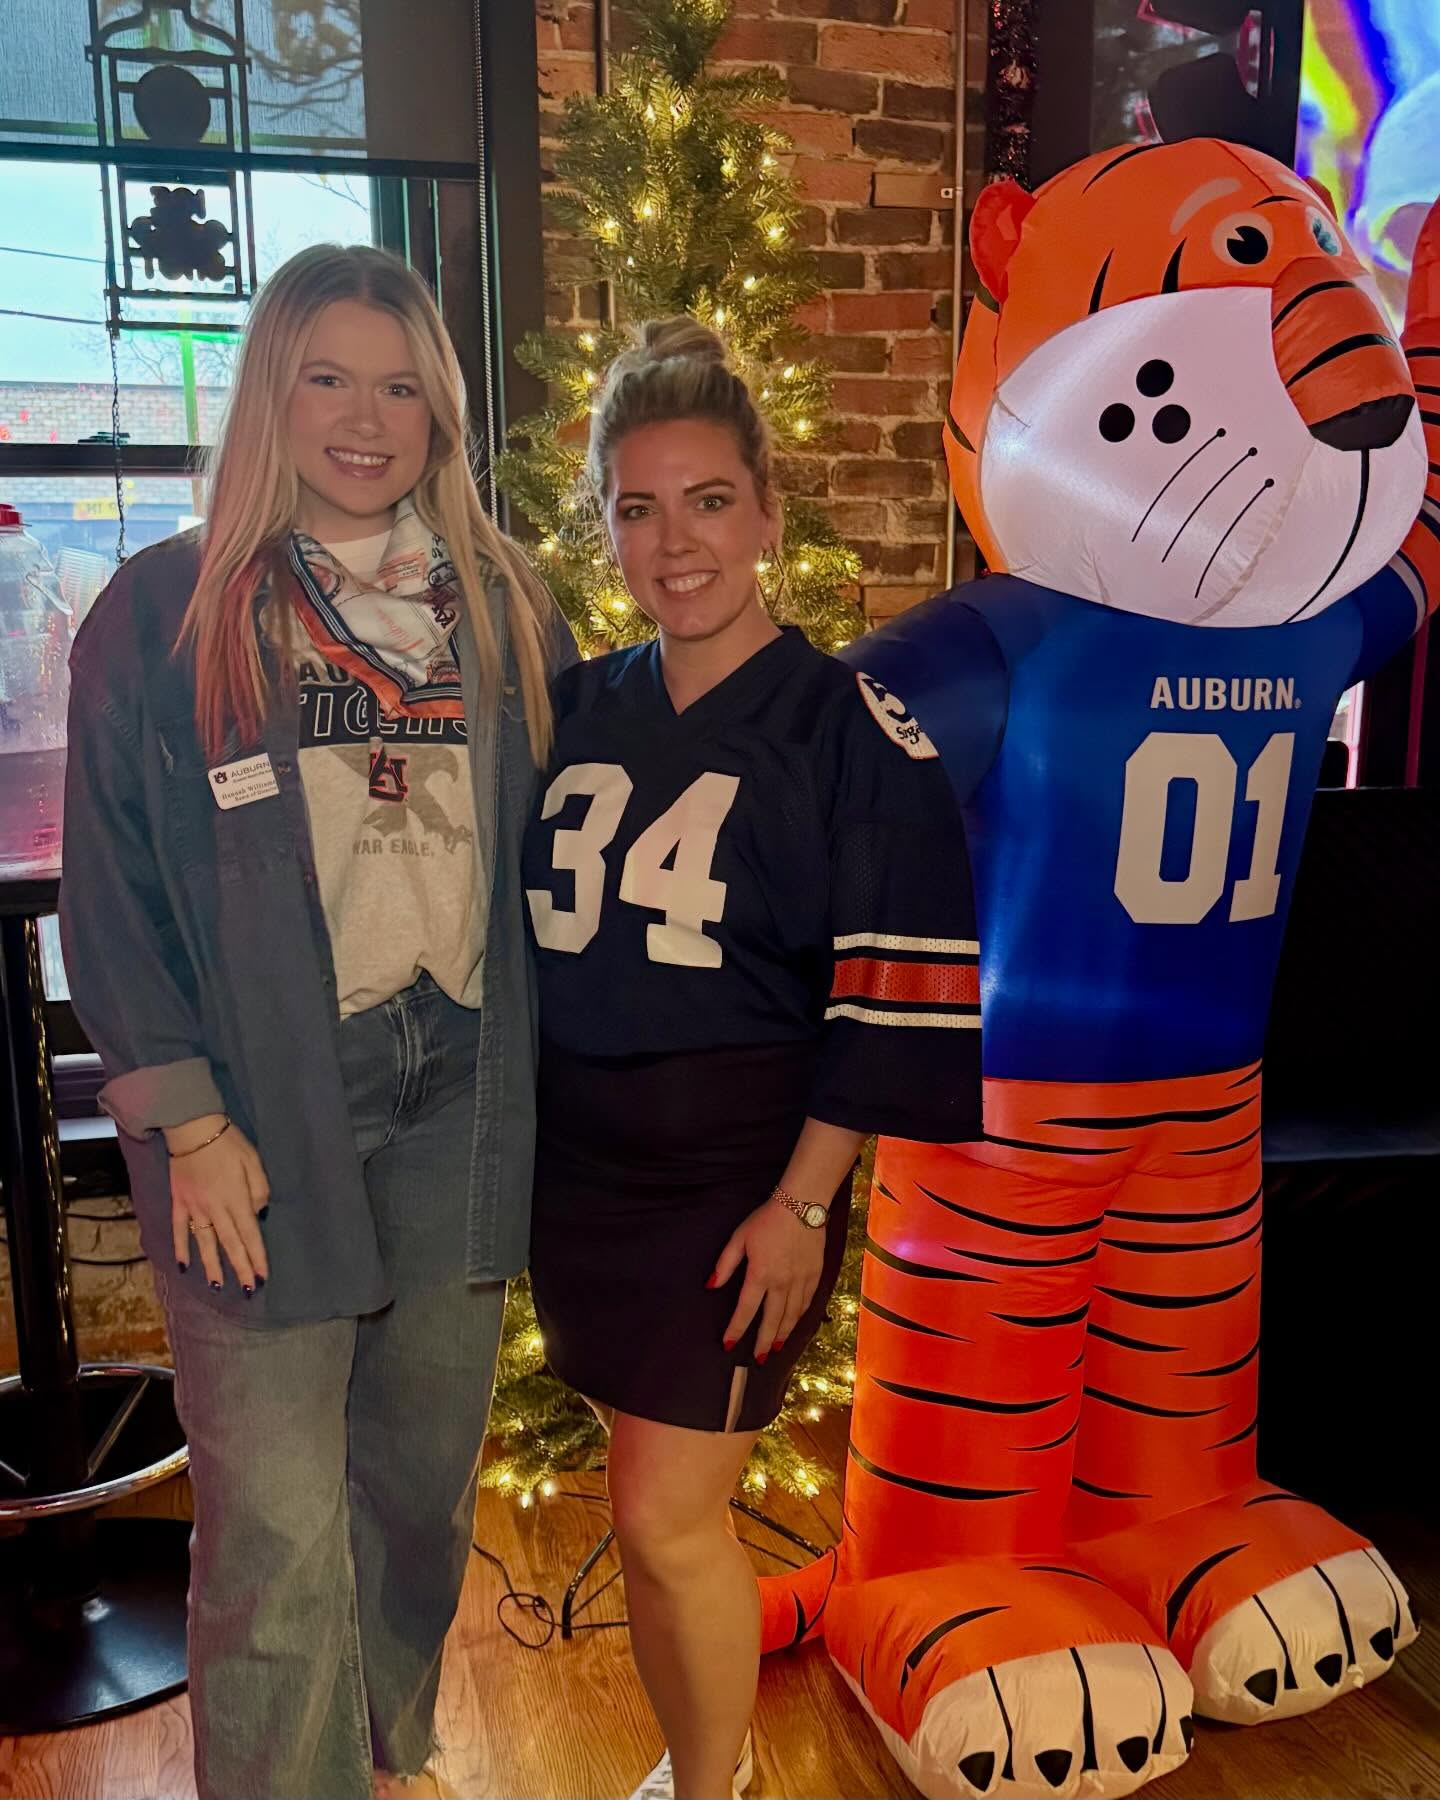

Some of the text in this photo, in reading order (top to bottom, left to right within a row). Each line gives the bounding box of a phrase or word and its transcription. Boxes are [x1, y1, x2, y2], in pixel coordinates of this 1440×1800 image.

[231, 762, 271, 778] AUBURN
[525, 762, 741, 969] 34
[1113, 731, 1296, 924] 01
